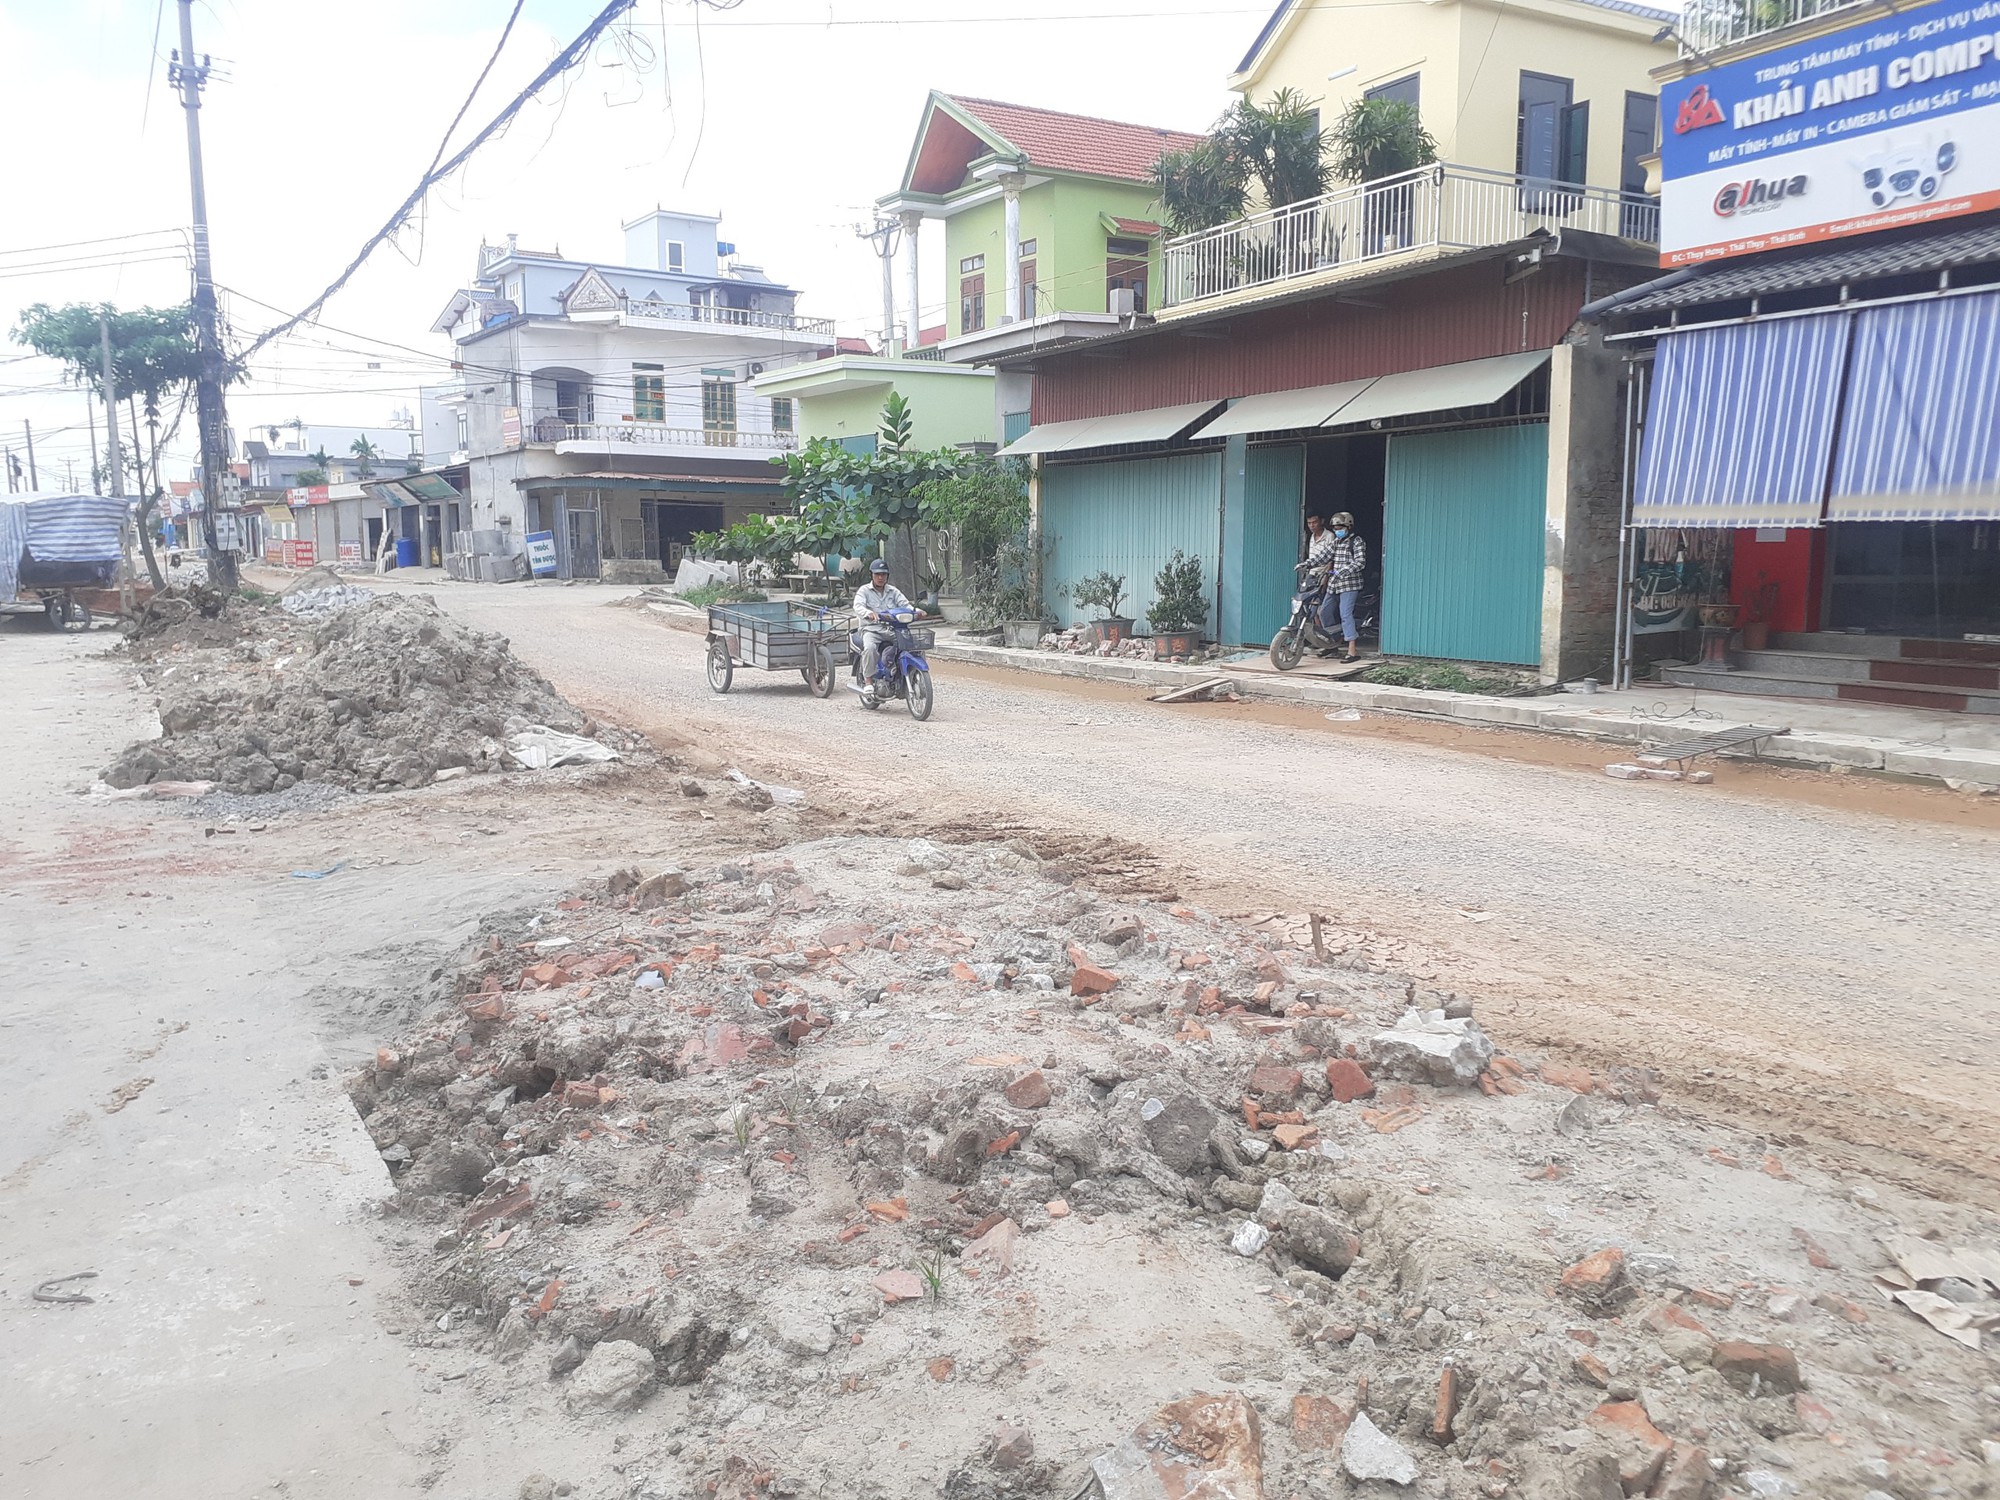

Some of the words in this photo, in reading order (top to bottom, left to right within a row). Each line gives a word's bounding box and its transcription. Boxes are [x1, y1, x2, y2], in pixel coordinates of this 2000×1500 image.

[1733, 79, 1806, 130] KHẢI
[1810, 64, 1879, 110] ANH
[1887, 31, 2000, 89] COMP
[1754, 60, 1800, 84] TRUNG
[1800, 52, 1832, 71] TÂM
[1831, 41, 1864, 63] MÁY
[1864, 30, 1900, 53] TÍNH
[1908, 17, 1947, 41] DỊCH
[1947, 10, 1971, 29] VỤ
[1708, 145, 1736, 164] MÁY
[1826, 109, 1888, 135] CAMERA
[1888, 98, 1930, 120] GIÁM
[1930, 88, 1962, 110] SÁT
[1972, 79, 2000, 100] MẠ
